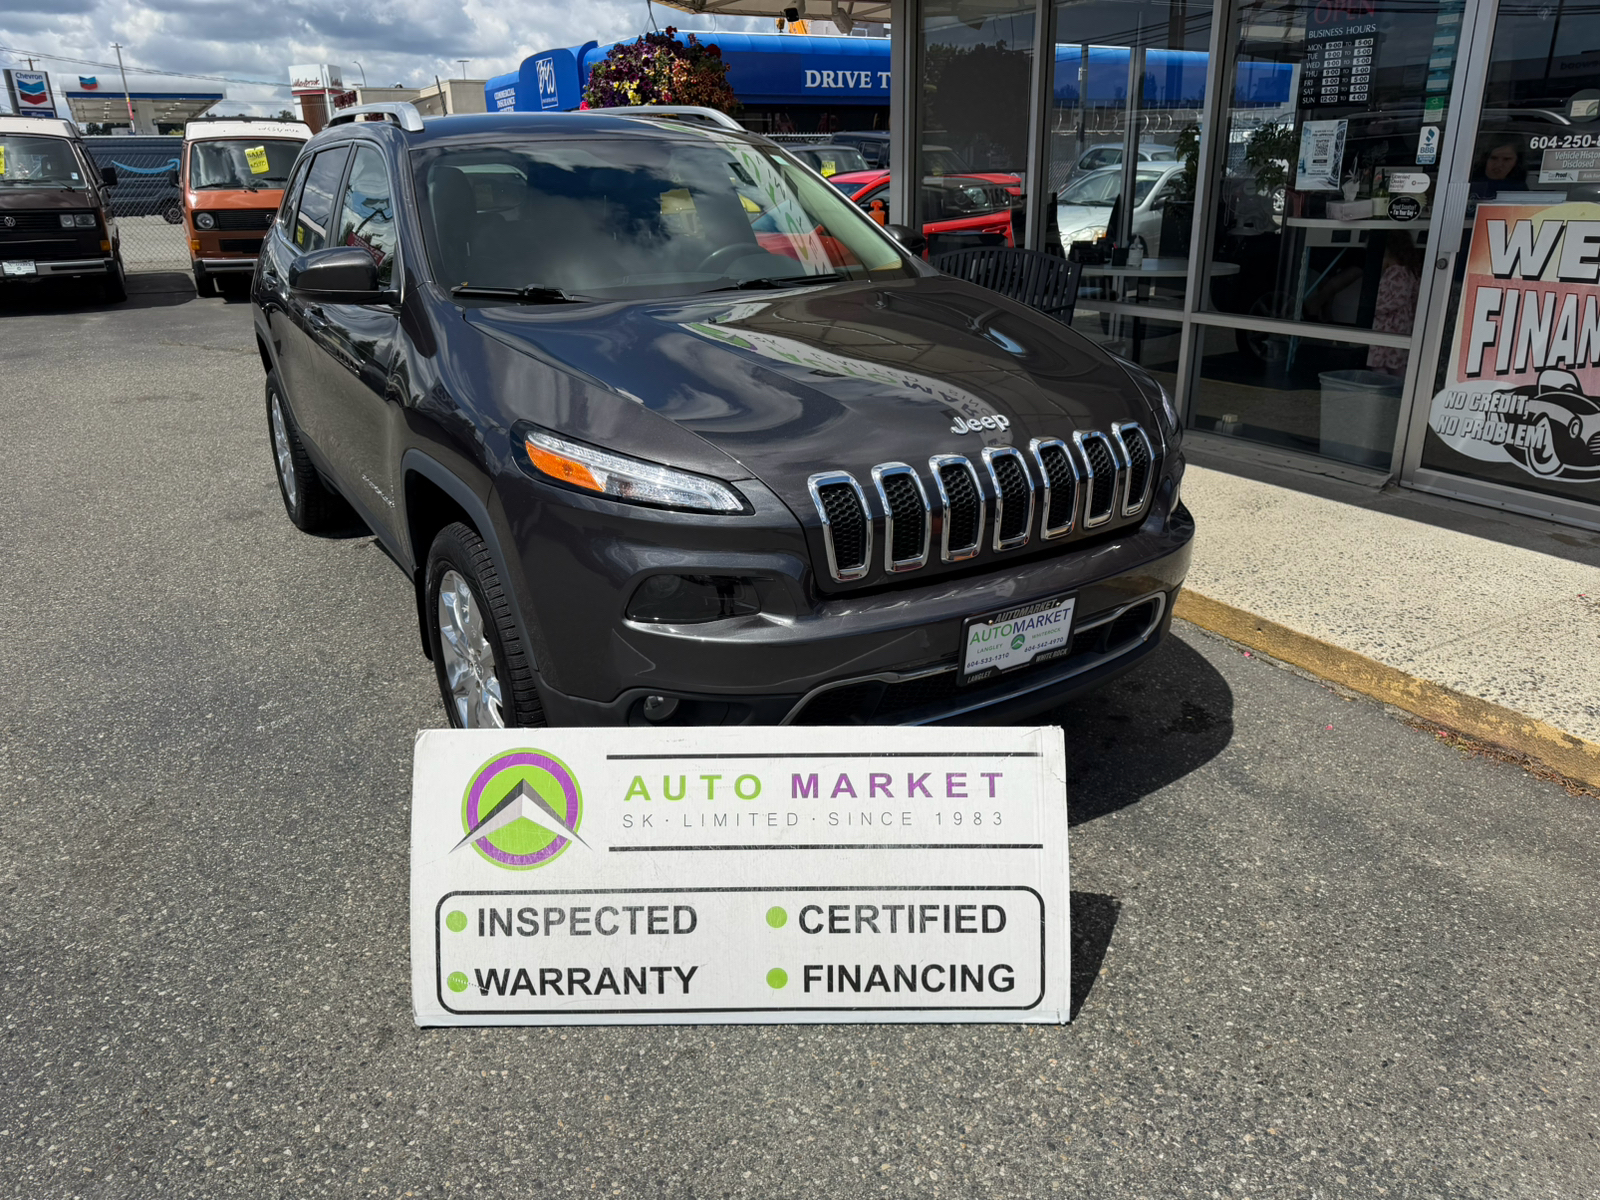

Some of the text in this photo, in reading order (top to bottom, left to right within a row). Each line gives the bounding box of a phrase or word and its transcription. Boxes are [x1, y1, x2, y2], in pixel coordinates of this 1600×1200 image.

[1308, 24, 1377, 39] BUSINESS HOURS
[1307, 43, 1323, 51] MON
[15, 72, 43, 80] Chevron
[805, 70, 872, 88] DRIVE
[1305, 70, 1318, 78] THU
[1303, 79, 1313, 87] FRI
[1555, 151, 1579, 160] Vehicle
[1562, 159, 1595, 168] Disclosed
[1486, 219, 1600, 283] WE
[1444, 390, 1529, 419] NO CREDIT,
[950, 414, 1011, 435] Jeep
[1436, 414, 1460, 436] NO
[994, 599, 1058, 623] AUTOMARKET
[969, 608, 1071, 646] AUTOMARKET
[1032, 627, 1061, 639] WHITEROCK
[977, 643, 1003, 654] LANGLEY
[1036, 648, 1068, 662] WHITE ROCK
[967, 652, 1009, 668] 604-533-1310
[967, 670, 992, 683] LANGLEY
[624, 772, 1004, 801] AUTO MARKET
[682, 812, 800, 828] LIMITED
[828, 811, 914, 827] SINCE
[934, 811, 1004, 827] 1983
[478, 905, 698, 937] INSPECTED
[798, 904, 1007, 935] CERTIFIED
[475, 965, 699, 996] WARRANTY
[802, 963, 1017, 994] FINANCING
